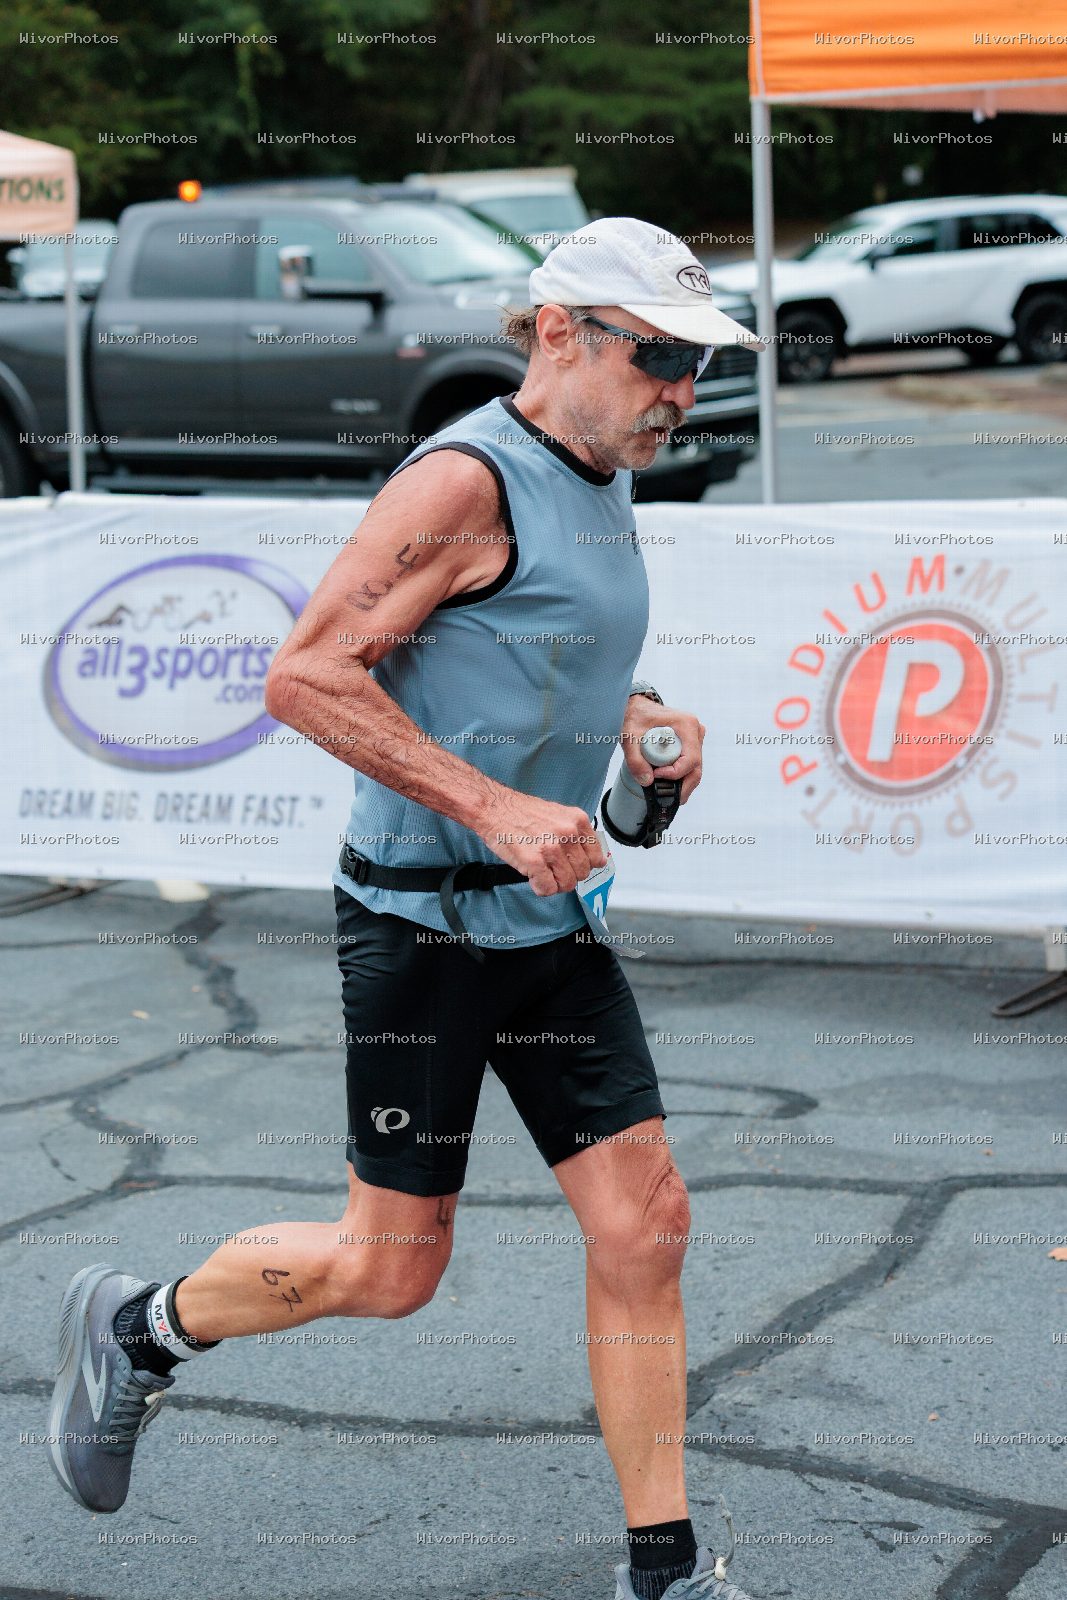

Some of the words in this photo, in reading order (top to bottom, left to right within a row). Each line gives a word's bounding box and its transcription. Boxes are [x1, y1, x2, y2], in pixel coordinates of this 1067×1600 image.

[77, 639, 272, 698] all3sports
[774, 554, 946, 785] PODIUM
[19, 787, 95, 819] DREAM
[154, 792, 234, 824] DREAM
[261, 1267, 303, 1313] 67
